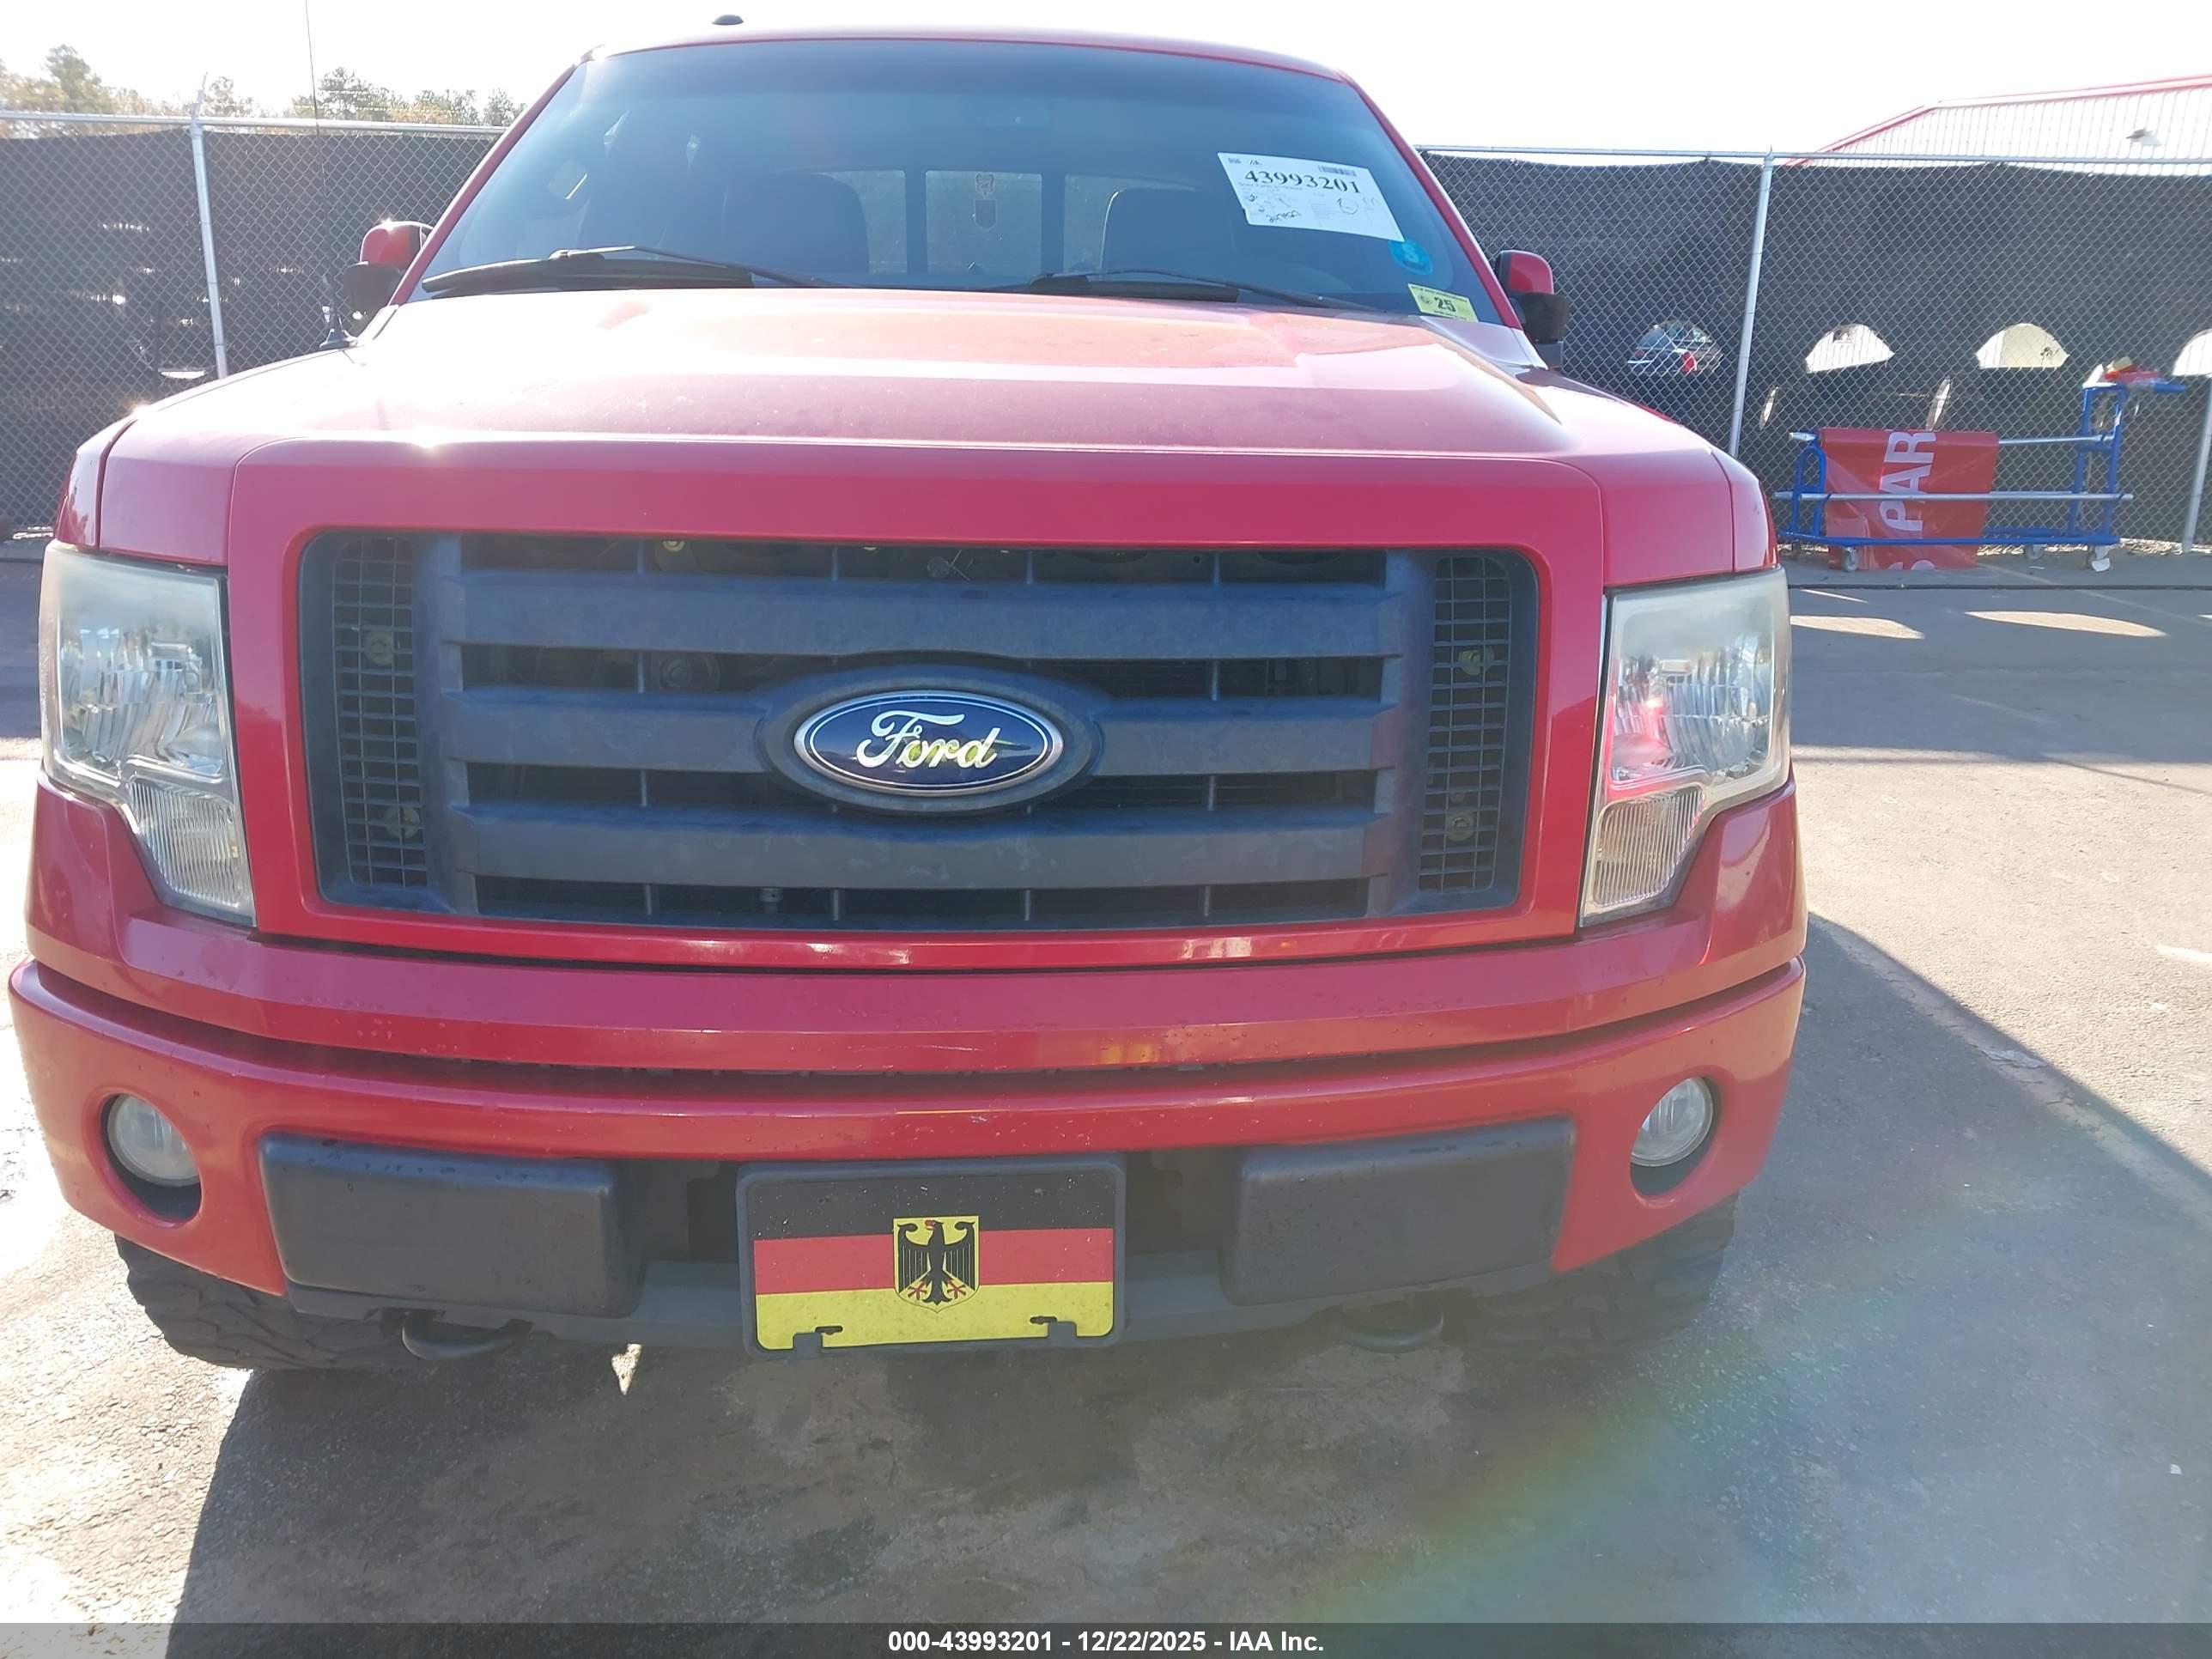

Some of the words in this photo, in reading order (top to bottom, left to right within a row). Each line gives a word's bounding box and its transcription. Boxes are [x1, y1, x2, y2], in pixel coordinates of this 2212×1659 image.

[1245, 170, 1360, 193] 43993201
[1433, 296, 1456, 313] 25
[855, 710, 1000, 769] Ford
